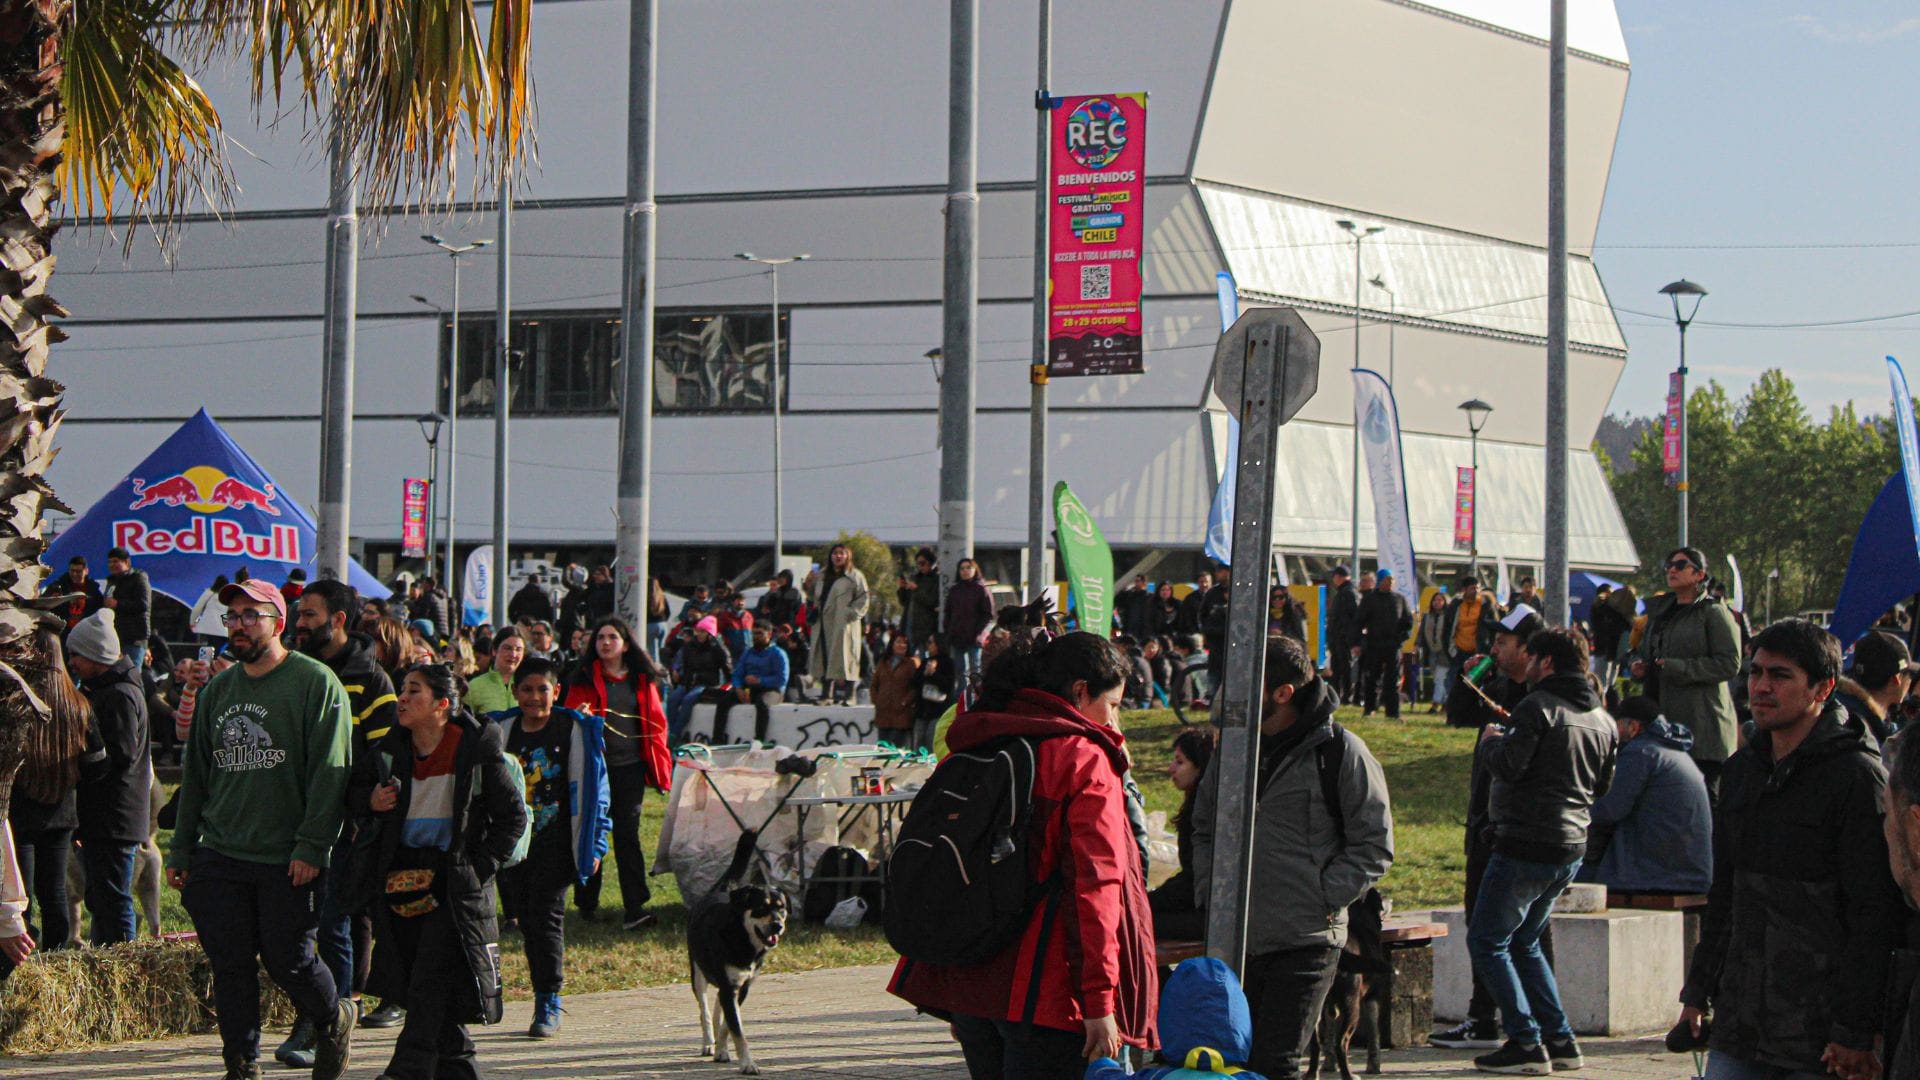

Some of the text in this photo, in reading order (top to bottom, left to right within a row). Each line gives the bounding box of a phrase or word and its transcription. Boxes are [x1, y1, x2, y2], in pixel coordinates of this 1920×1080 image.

[1068, 120, 1127, 147] REC
[1058, 170, 1136, 186] BIENVENIDOS
[1058, 194, 1092, 204] FESTIVAL
[1072, 203, 1112, 213] GRATUITO
[1084, 230, 1115, 241] CHILE
[1091, 315, 1127, 325] OCTUBRE
[113, 516, 300, 564] Red Bull
[244, 704, 268, 718] HIGH
[213, 744, 286, 769] Bulldogs
